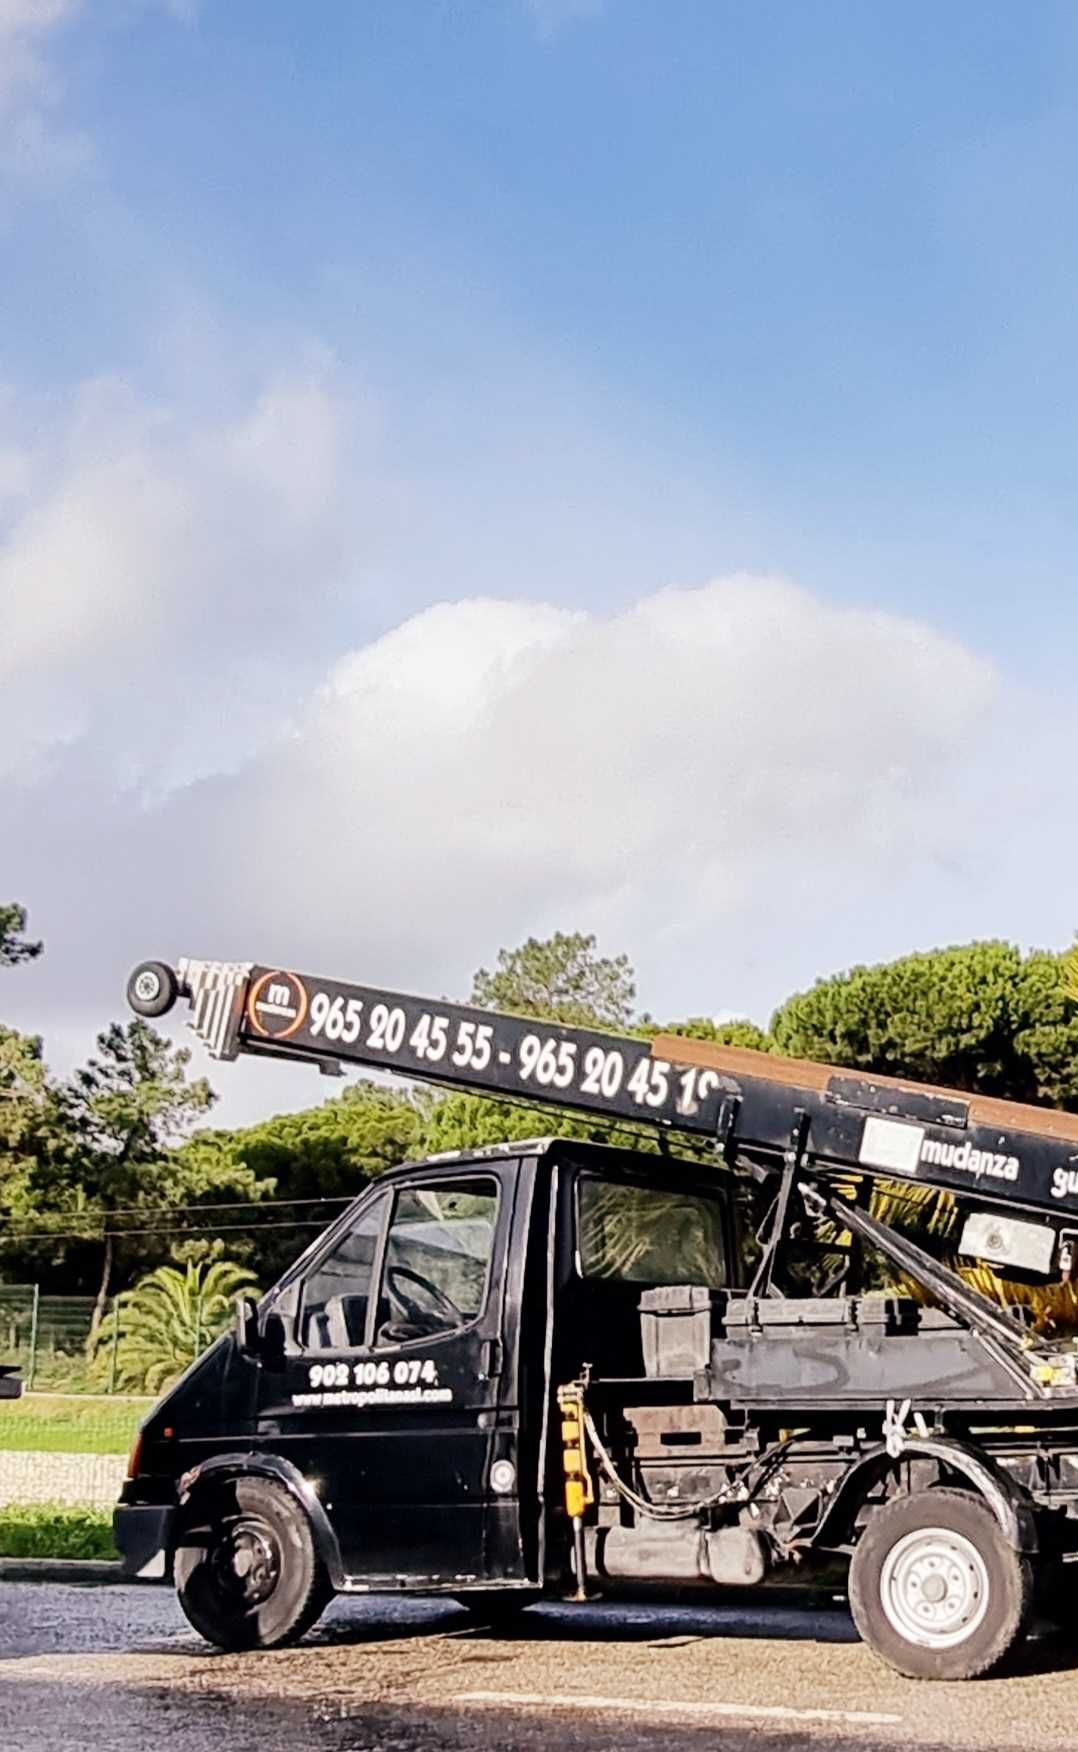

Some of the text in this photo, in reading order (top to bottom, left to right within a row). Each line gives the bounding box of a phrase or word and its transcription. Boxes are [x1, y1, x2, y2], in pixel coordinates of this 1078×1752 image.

[267, 983, 290, 1006] m
[309, 992, 363, 1044] 965
[365, 1003, 405, 1053] 20
[409, 1013, 449, 1062] 45
[452, 1021, 493, 1071] 55
[519, 1034, 577, 1088] 965
[580, 1046, 623, 1098] 20
[627, 1057, 671, 1107] 45
[920, 1138, 1020, 1181] mudanza
[309, 1359, 438, 1388] 902 106 074
